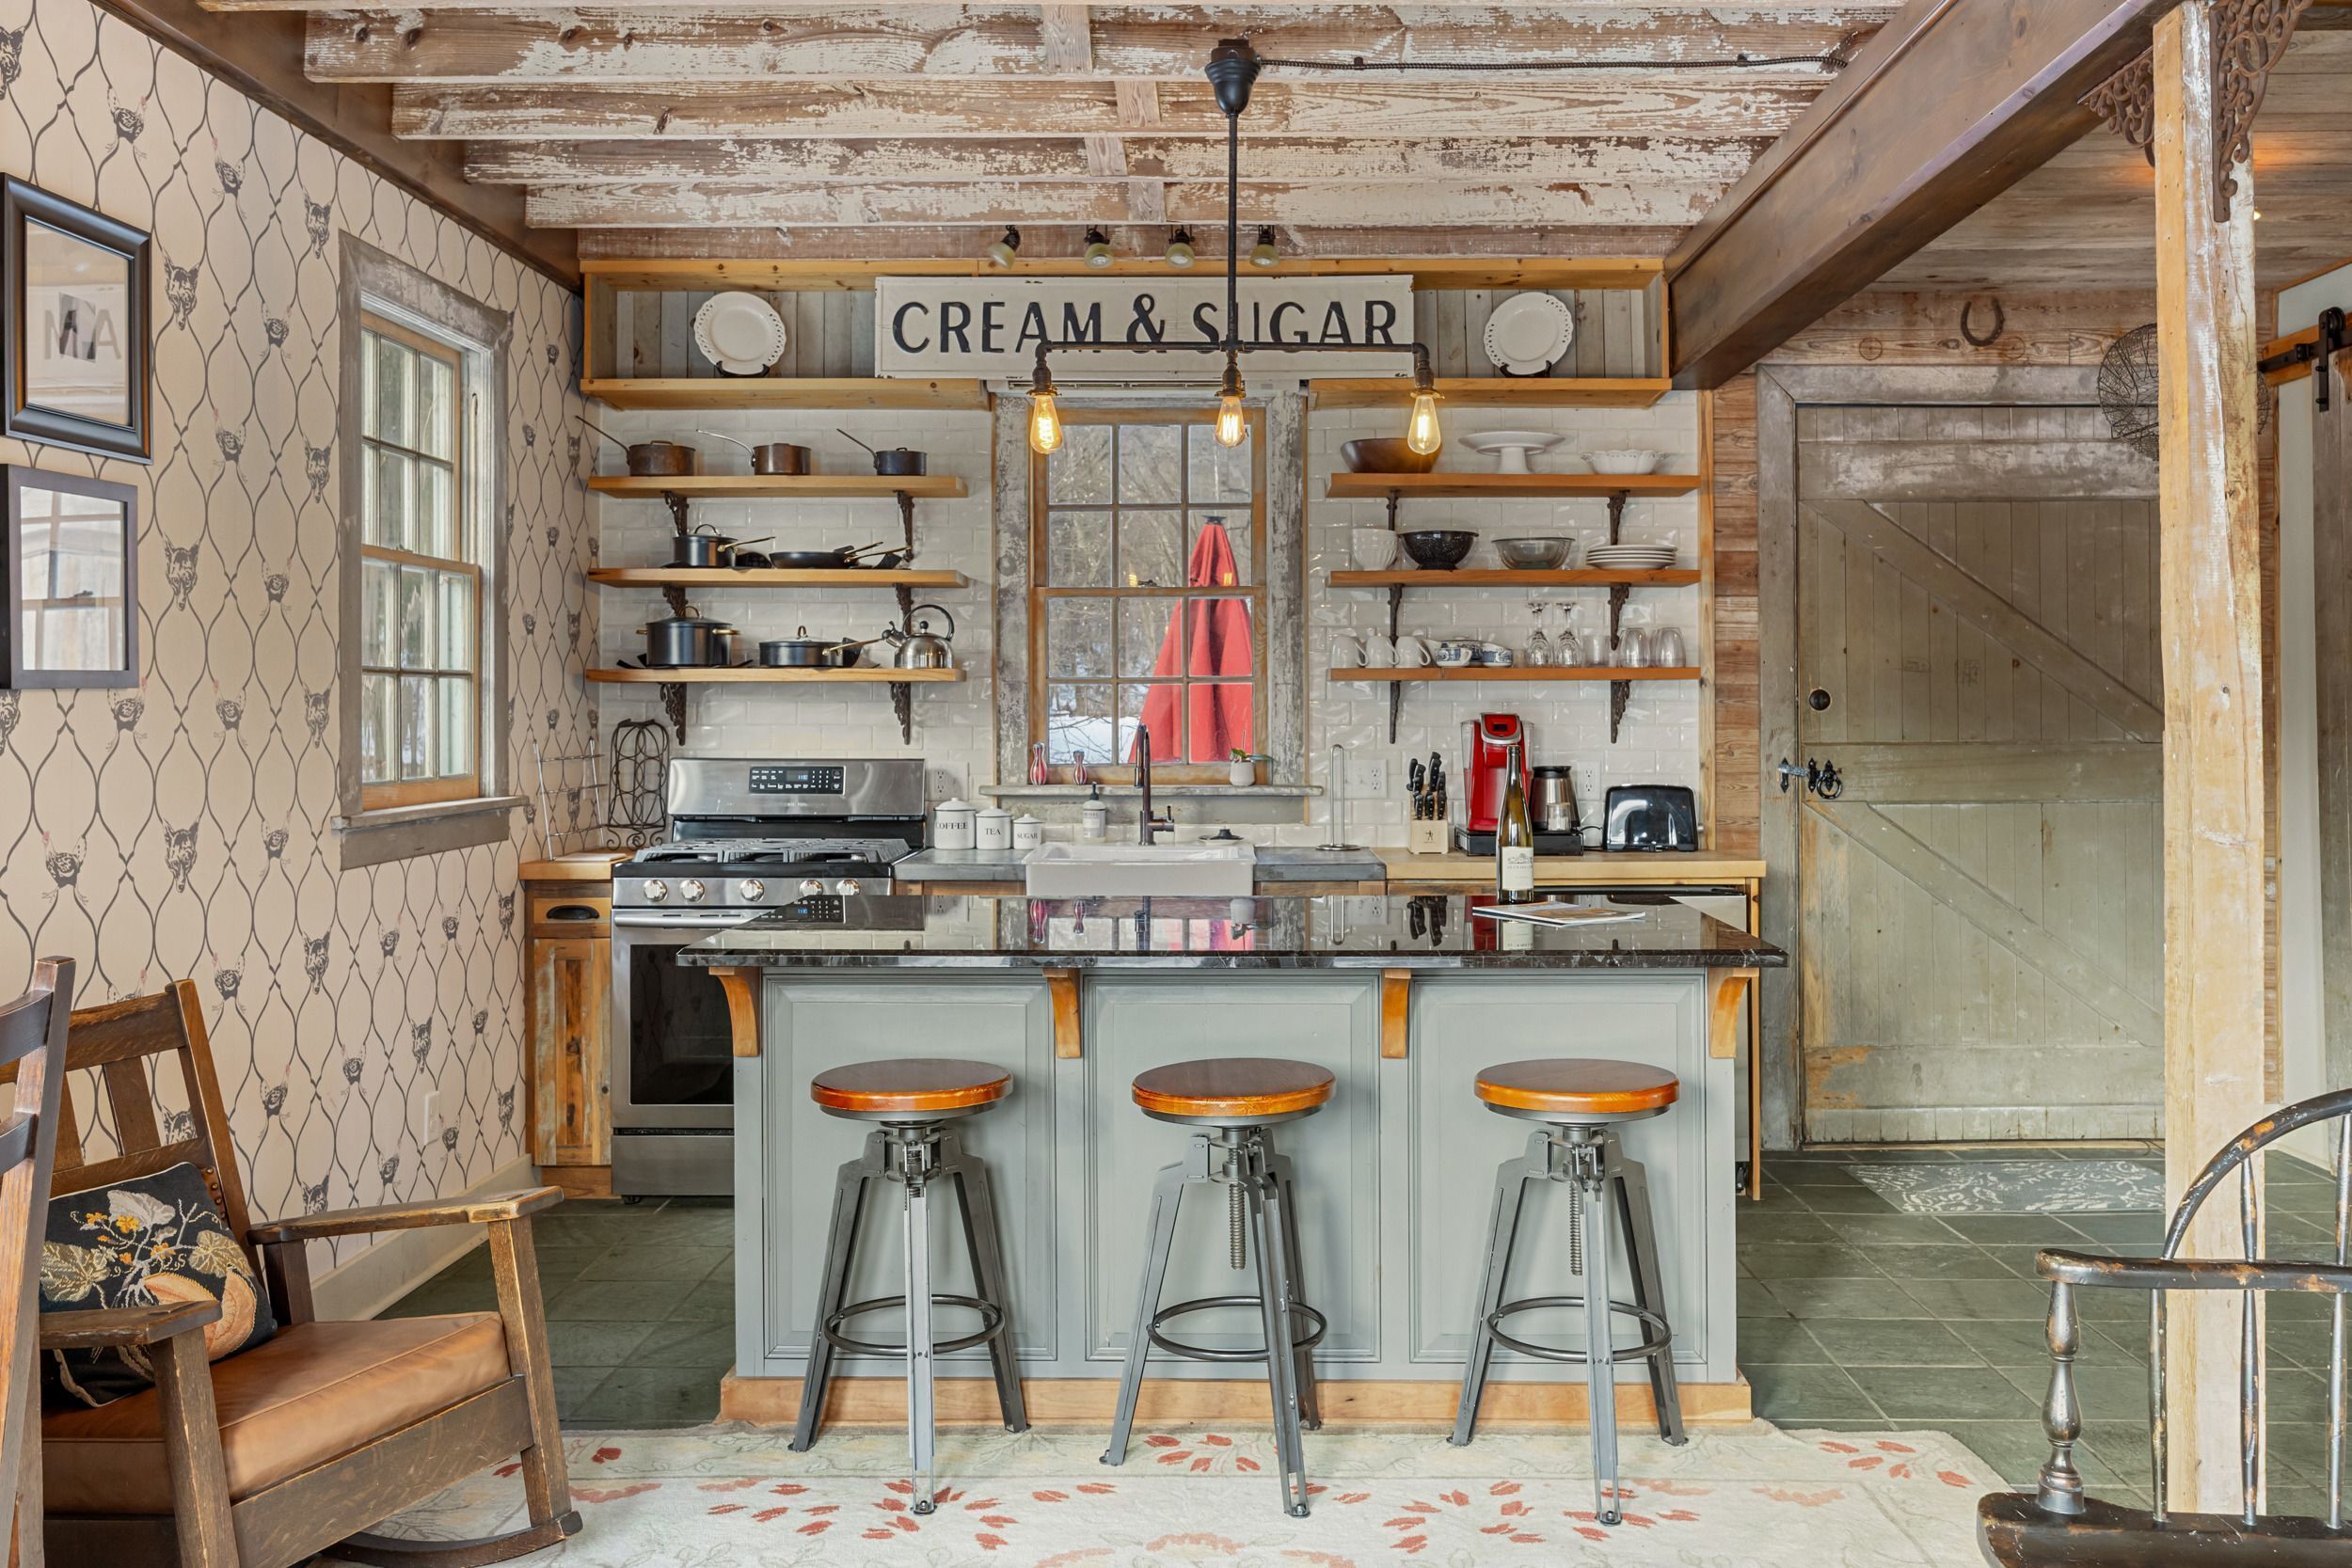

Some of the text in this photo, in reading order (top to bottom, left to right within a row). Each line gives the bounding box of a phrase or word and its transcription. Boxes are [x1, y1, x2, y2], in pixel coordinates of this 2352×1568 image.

[893, 301, 1102, 354] CREAM
[1126, 293, 1166, 354] &
[935, 821, 969, 830] COFFEE
